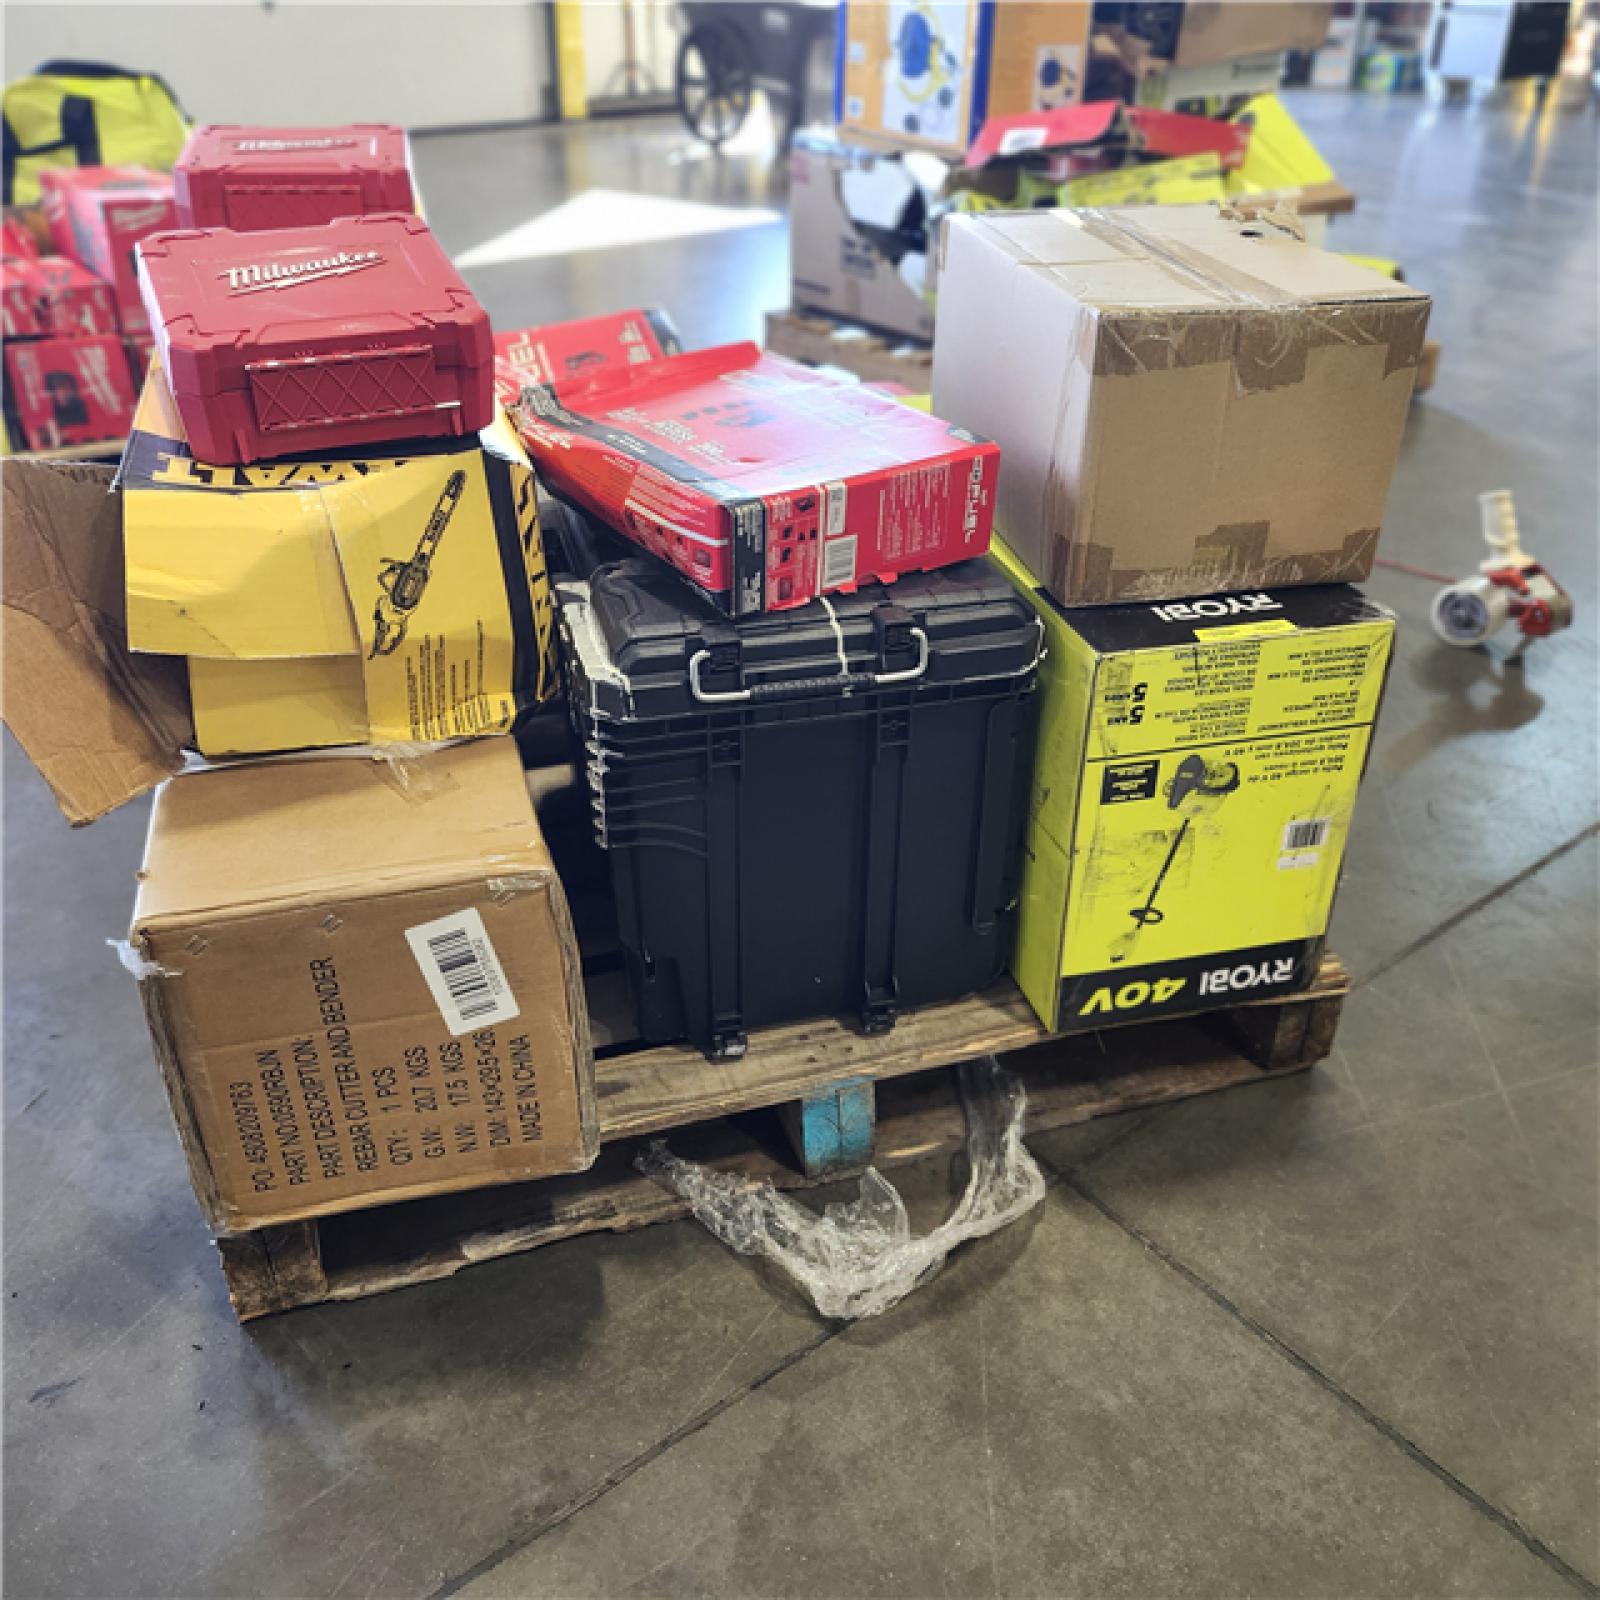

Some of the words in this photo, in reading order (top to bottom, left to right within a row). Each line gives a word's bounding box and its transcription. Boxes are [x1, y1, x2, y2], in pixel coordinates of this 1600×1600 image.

[217, 250, 384, 290] Milwaukee
[1151, 592, 1284, 622] RYOBI
[309, 956, 346, 1026] BENDER
[1198, 957, 1294, 995] RYOBI
[1077, 977, 1187, 1016] 40V
[327, 1026, 355, 1059] AND
[439, 1039, 465, 1073] KGS
[507, 1032, 535, 1081] CHINA
[404, 1044, 431, 1080] KGS
[334, 1058, 370, 1121] CUTTER
[372, 1066, 399, 1099] PCS
[514, 1082, 537, 1100] IN
[516, 1100, 543, 1144] MADE
[316, 1142, 345, 1179] PART
[350, 1121, 379, 1173] REBAR
[281, 1149, 312, 1186] PART
